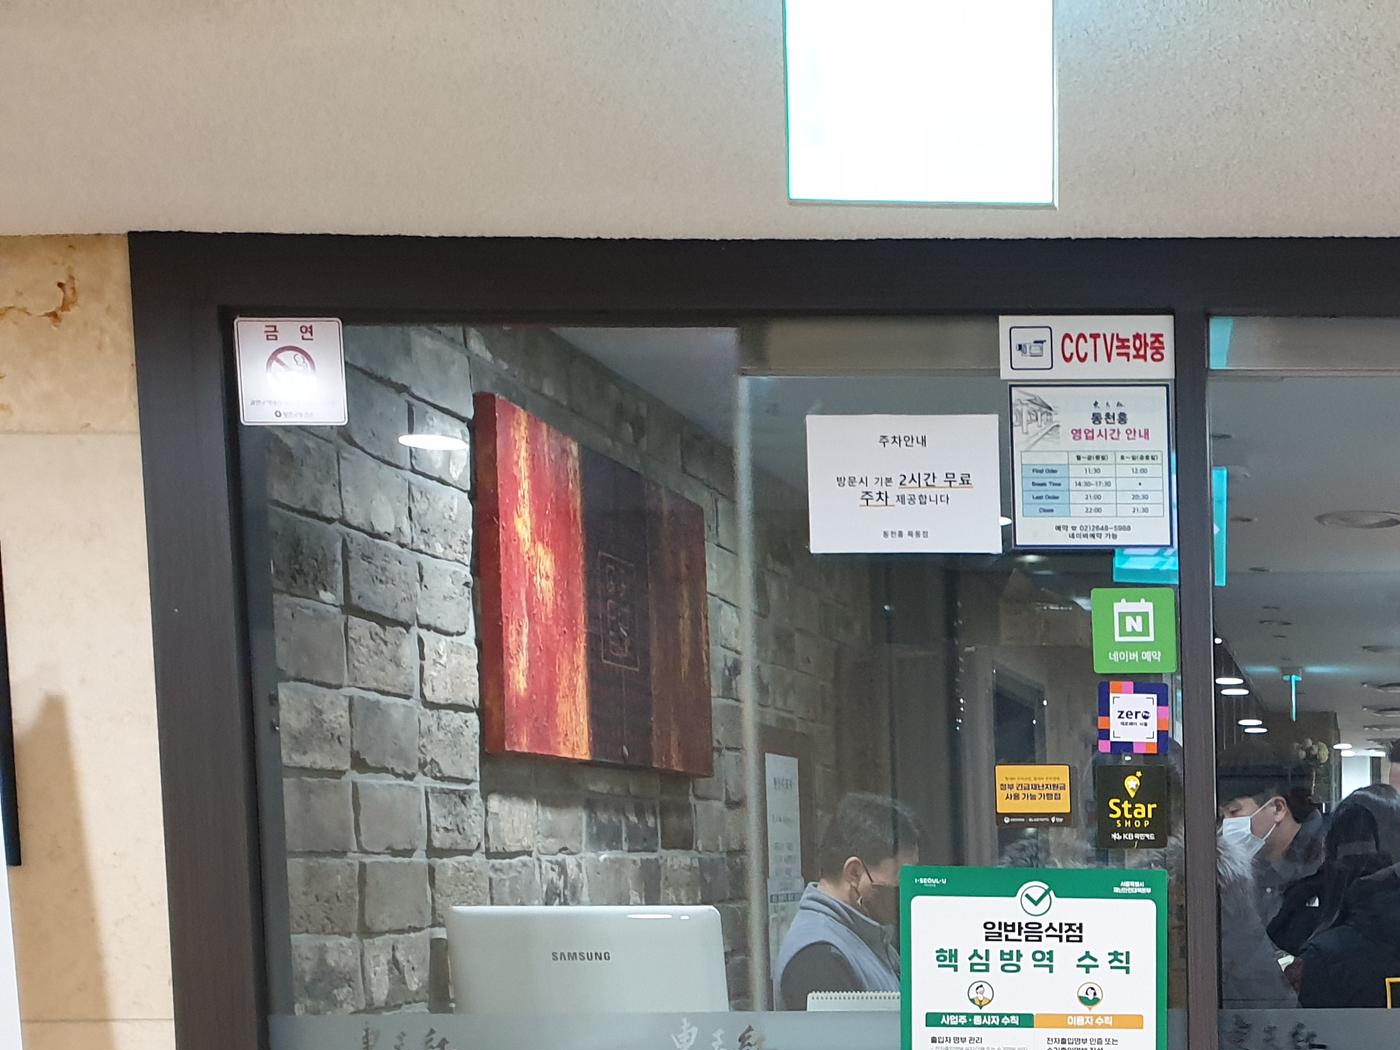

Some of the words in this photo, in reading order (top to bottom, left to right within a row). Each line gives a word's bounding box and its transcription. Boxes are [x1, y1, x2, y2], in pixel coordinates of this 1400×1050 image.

[1061, 332, 1165, 363] CCTV녹화중
[1091, 412, 1128, 425] 동천홍
[878, 434, 927, 448] 주차안내
[1070, 428, 1121, 441] 영업시간
[1125, 428, 1150, 441] 안내
[836, 475, 869, 487] 방문시
[873, 476, 894, 487] 기본
[899, 472, 937, 488] 2시간
[943, 472, 973, 488] 무료
[860, 490, 889, 506] 주차
[895, 493, 950, 505] 제공합니다
[1108, 650, 1139, 662] 네이버
[1141, 650, 1162, 662] 예약
[1005, 793, 1020, 801] 사용
[1021, 793, 1037, 801] 가능
[1108, 798, 1157, 819] Star
[1116, 820, 1150, 828] SHOP
[983, 920, 1084, 943] 일반음식점
[551, 951, 611, 962] SAMSUNG
[935, 948, 1054, 974] 핵심방역
[1076, 950, 1131, 975] 수칙
[1001, 1015, 1019, 1025] 수칙
[1067, 1015, 1093, 1026] 이용자
[1095, 1015, 1113, 1026] 수칙
[930, 1036, 951, 1044] 출입자
[953, 1036, 967, 1044] 명부
[968, 1036, 983, 1044] 관리
[1046, 1037, 1088, 1045] 전자출입명부
[1089, 1037, 1103, 1045] 인증
[1104, 1037, 1119, 1045] 또는
